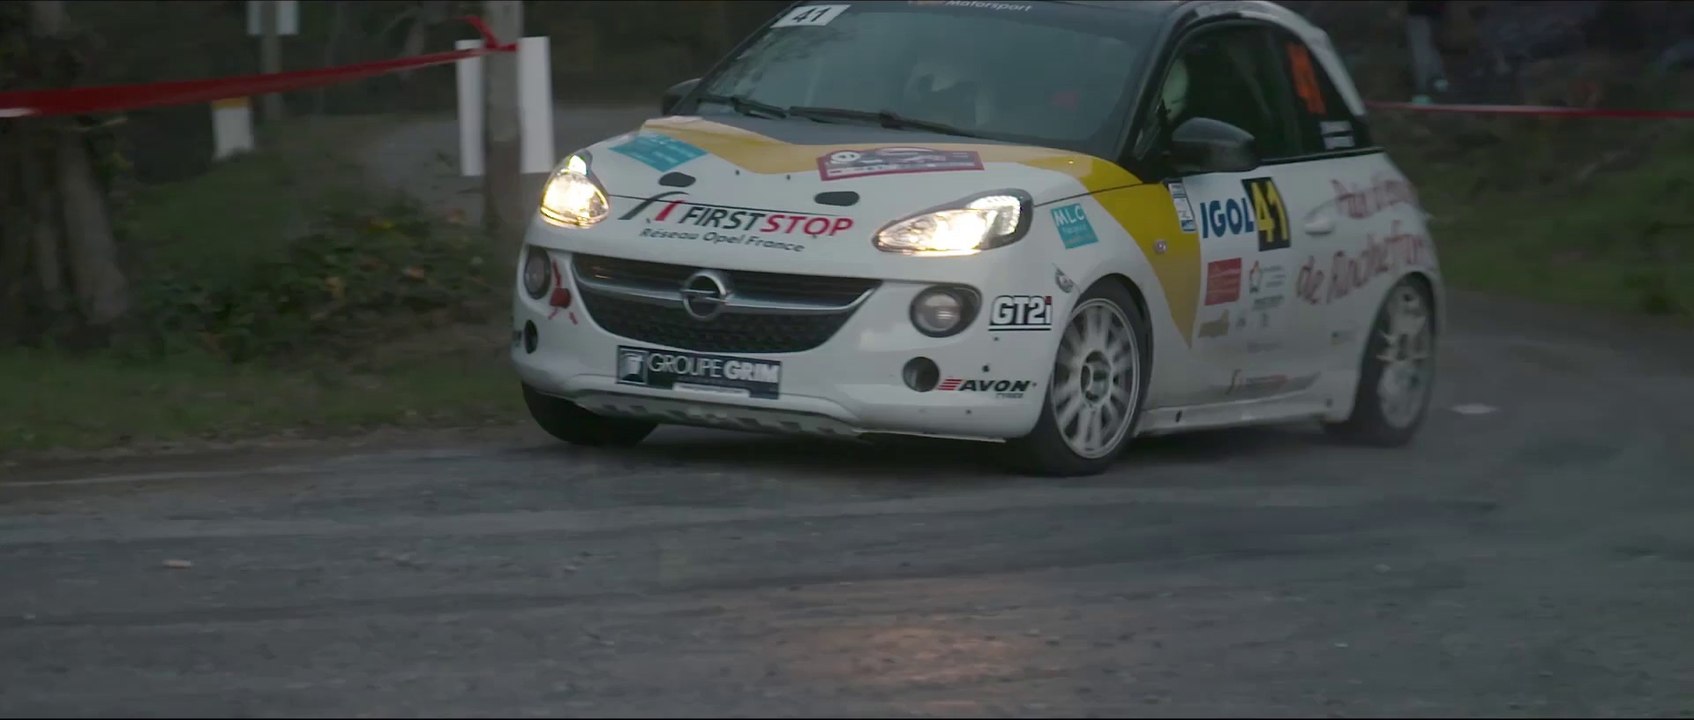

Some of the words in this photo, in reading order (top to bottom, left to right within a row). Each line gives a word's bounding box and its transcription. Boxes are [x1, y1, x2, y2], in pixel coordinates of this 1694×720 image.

[791, 6, 832, 23] 41
[944, 0, 1033, 12] Motorsport
[1053, 205, 1085, 227] MLC
[1199, 197, 1255, 239] IGOL
[1250, 180, 1289, 243] 41
[639, 228, 699, 240] Réseau
[701, 231, 745, 245] Opel
[747, 236, 806, 252] France
[990, 295, 1053, 326] GT2i
[959, 379, 1031, 392] AVON
